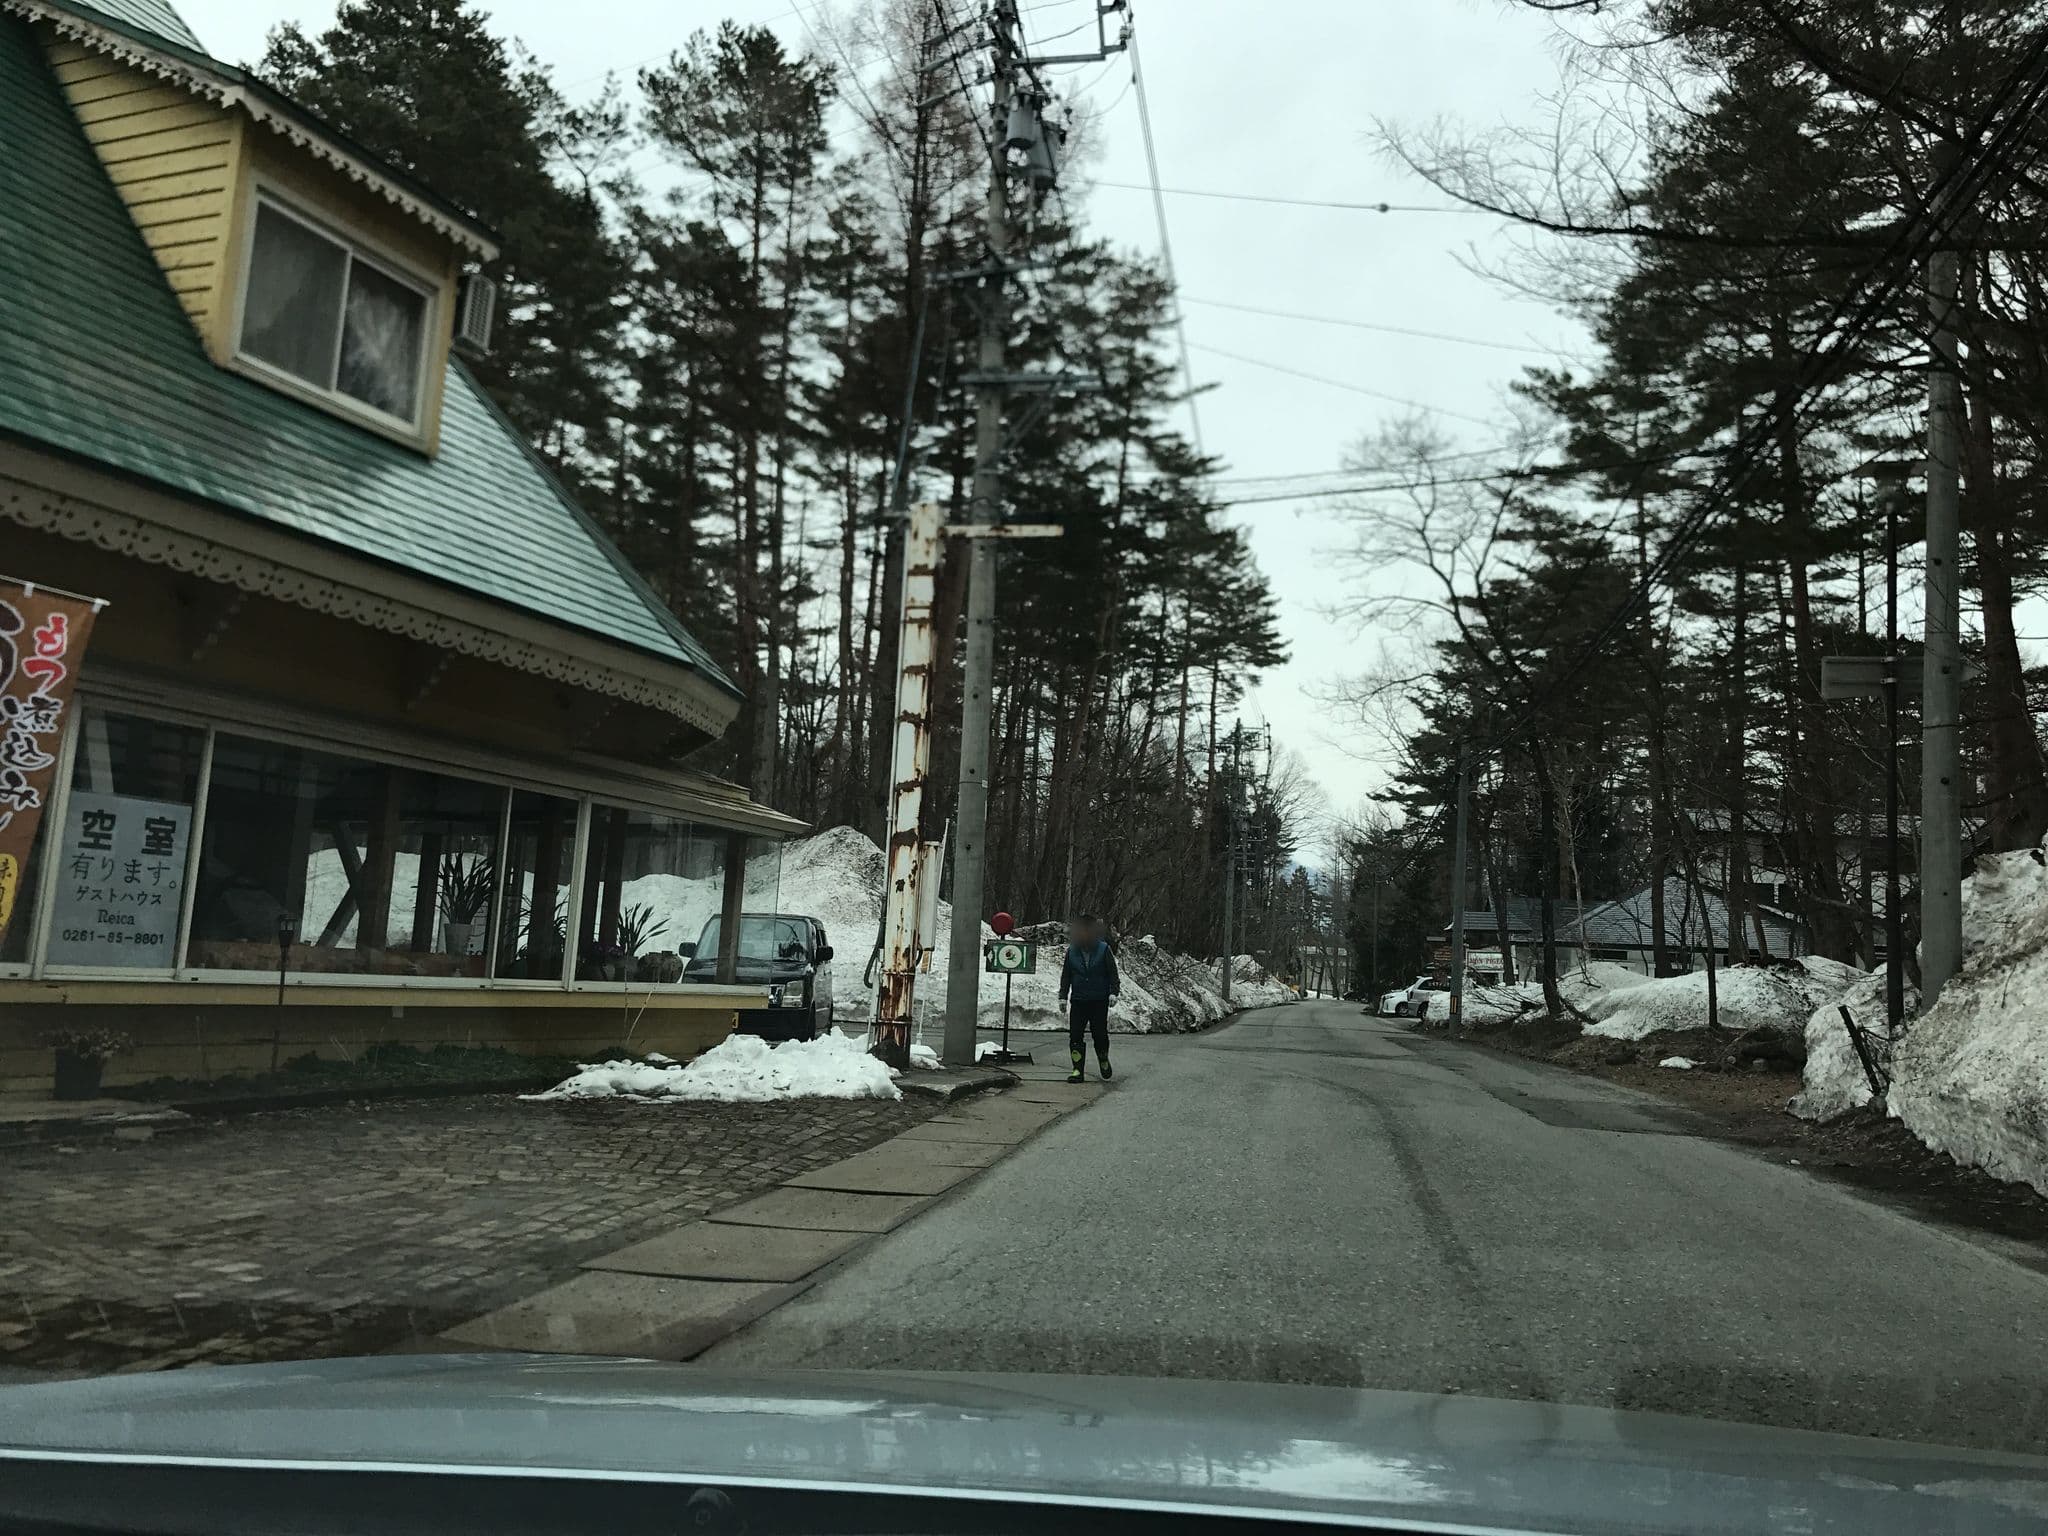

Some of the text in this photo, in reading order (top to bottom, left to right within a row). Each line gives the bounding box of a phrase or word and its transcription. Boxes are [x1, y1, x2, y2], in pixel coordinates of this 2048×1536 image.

[71, 853, 177, 889] 有ります。
[76, 885, 162, 906] ゲストハウス
[97, 909, 136, 925] Reica
